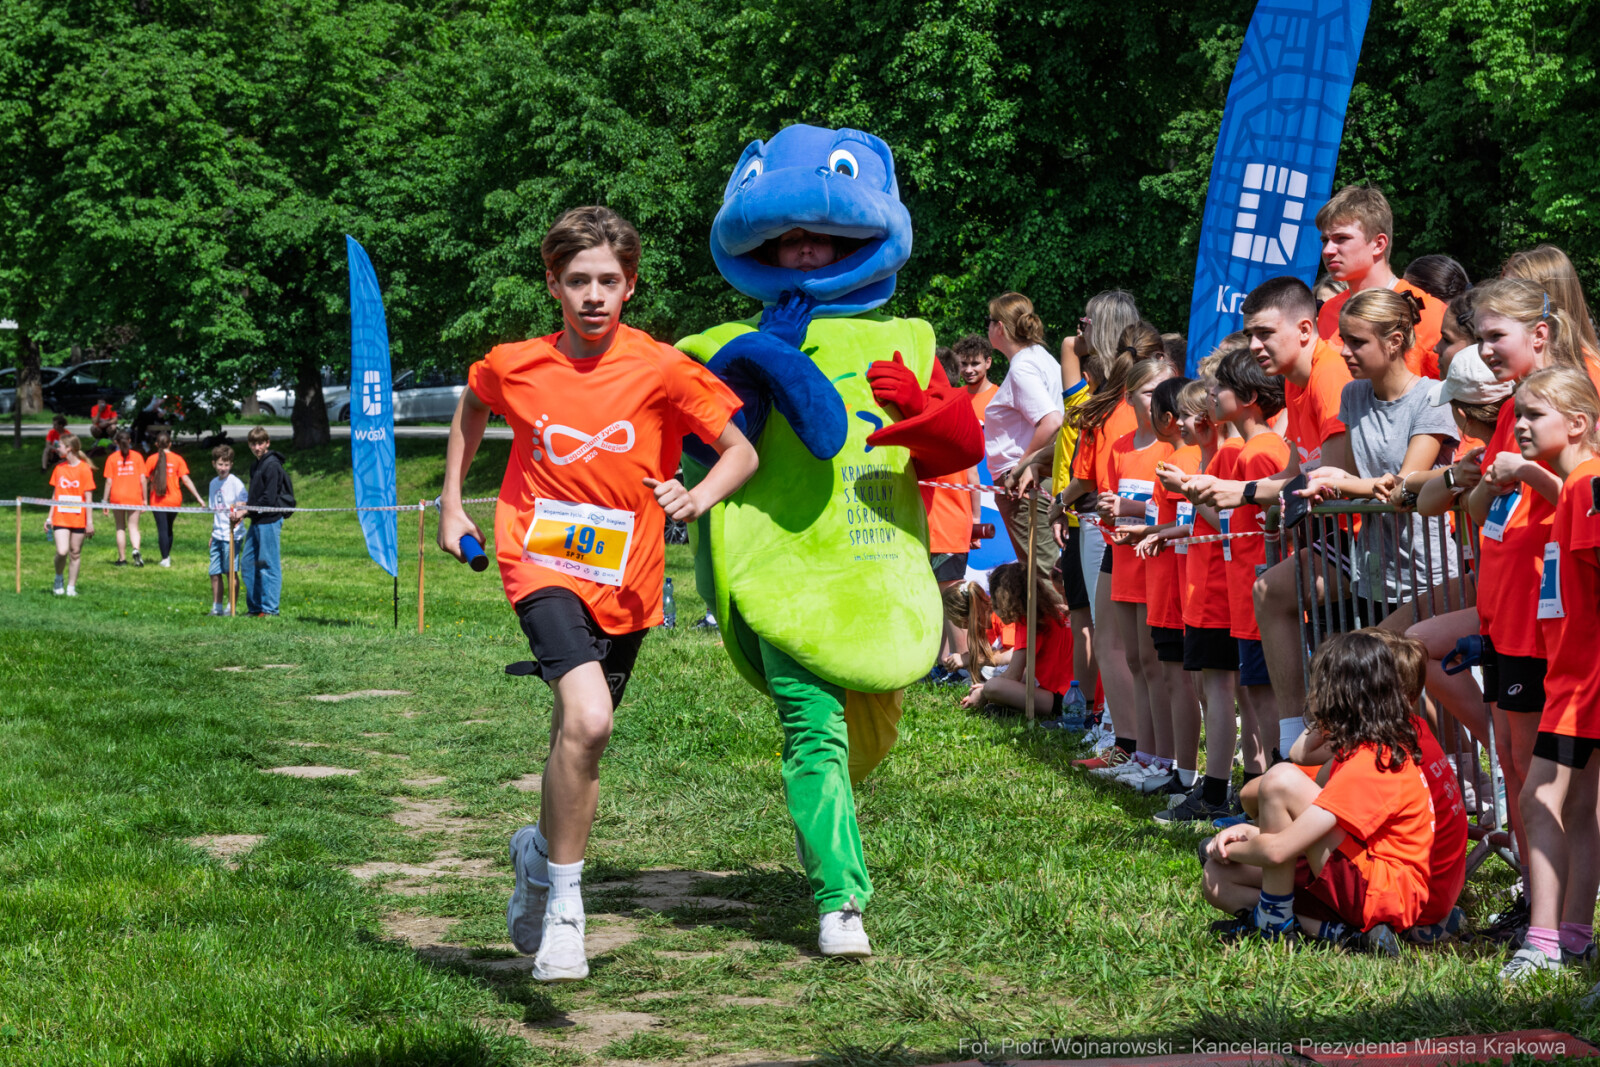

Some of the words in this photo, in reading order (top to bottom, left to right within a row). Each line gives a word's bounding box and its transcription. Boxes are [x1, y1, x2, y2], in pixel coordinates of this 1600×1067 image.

[600, 423, 620, 438] życie
[601, 441, 628, 451] biegiem
[841, 464, 893, 482] KRAKOWSKI
[844, 486, 893, 503] SZKOLNY
[847, 505, 895, 524] OŚRODEK
[849, 528, 896, 545] SPORTOWY
